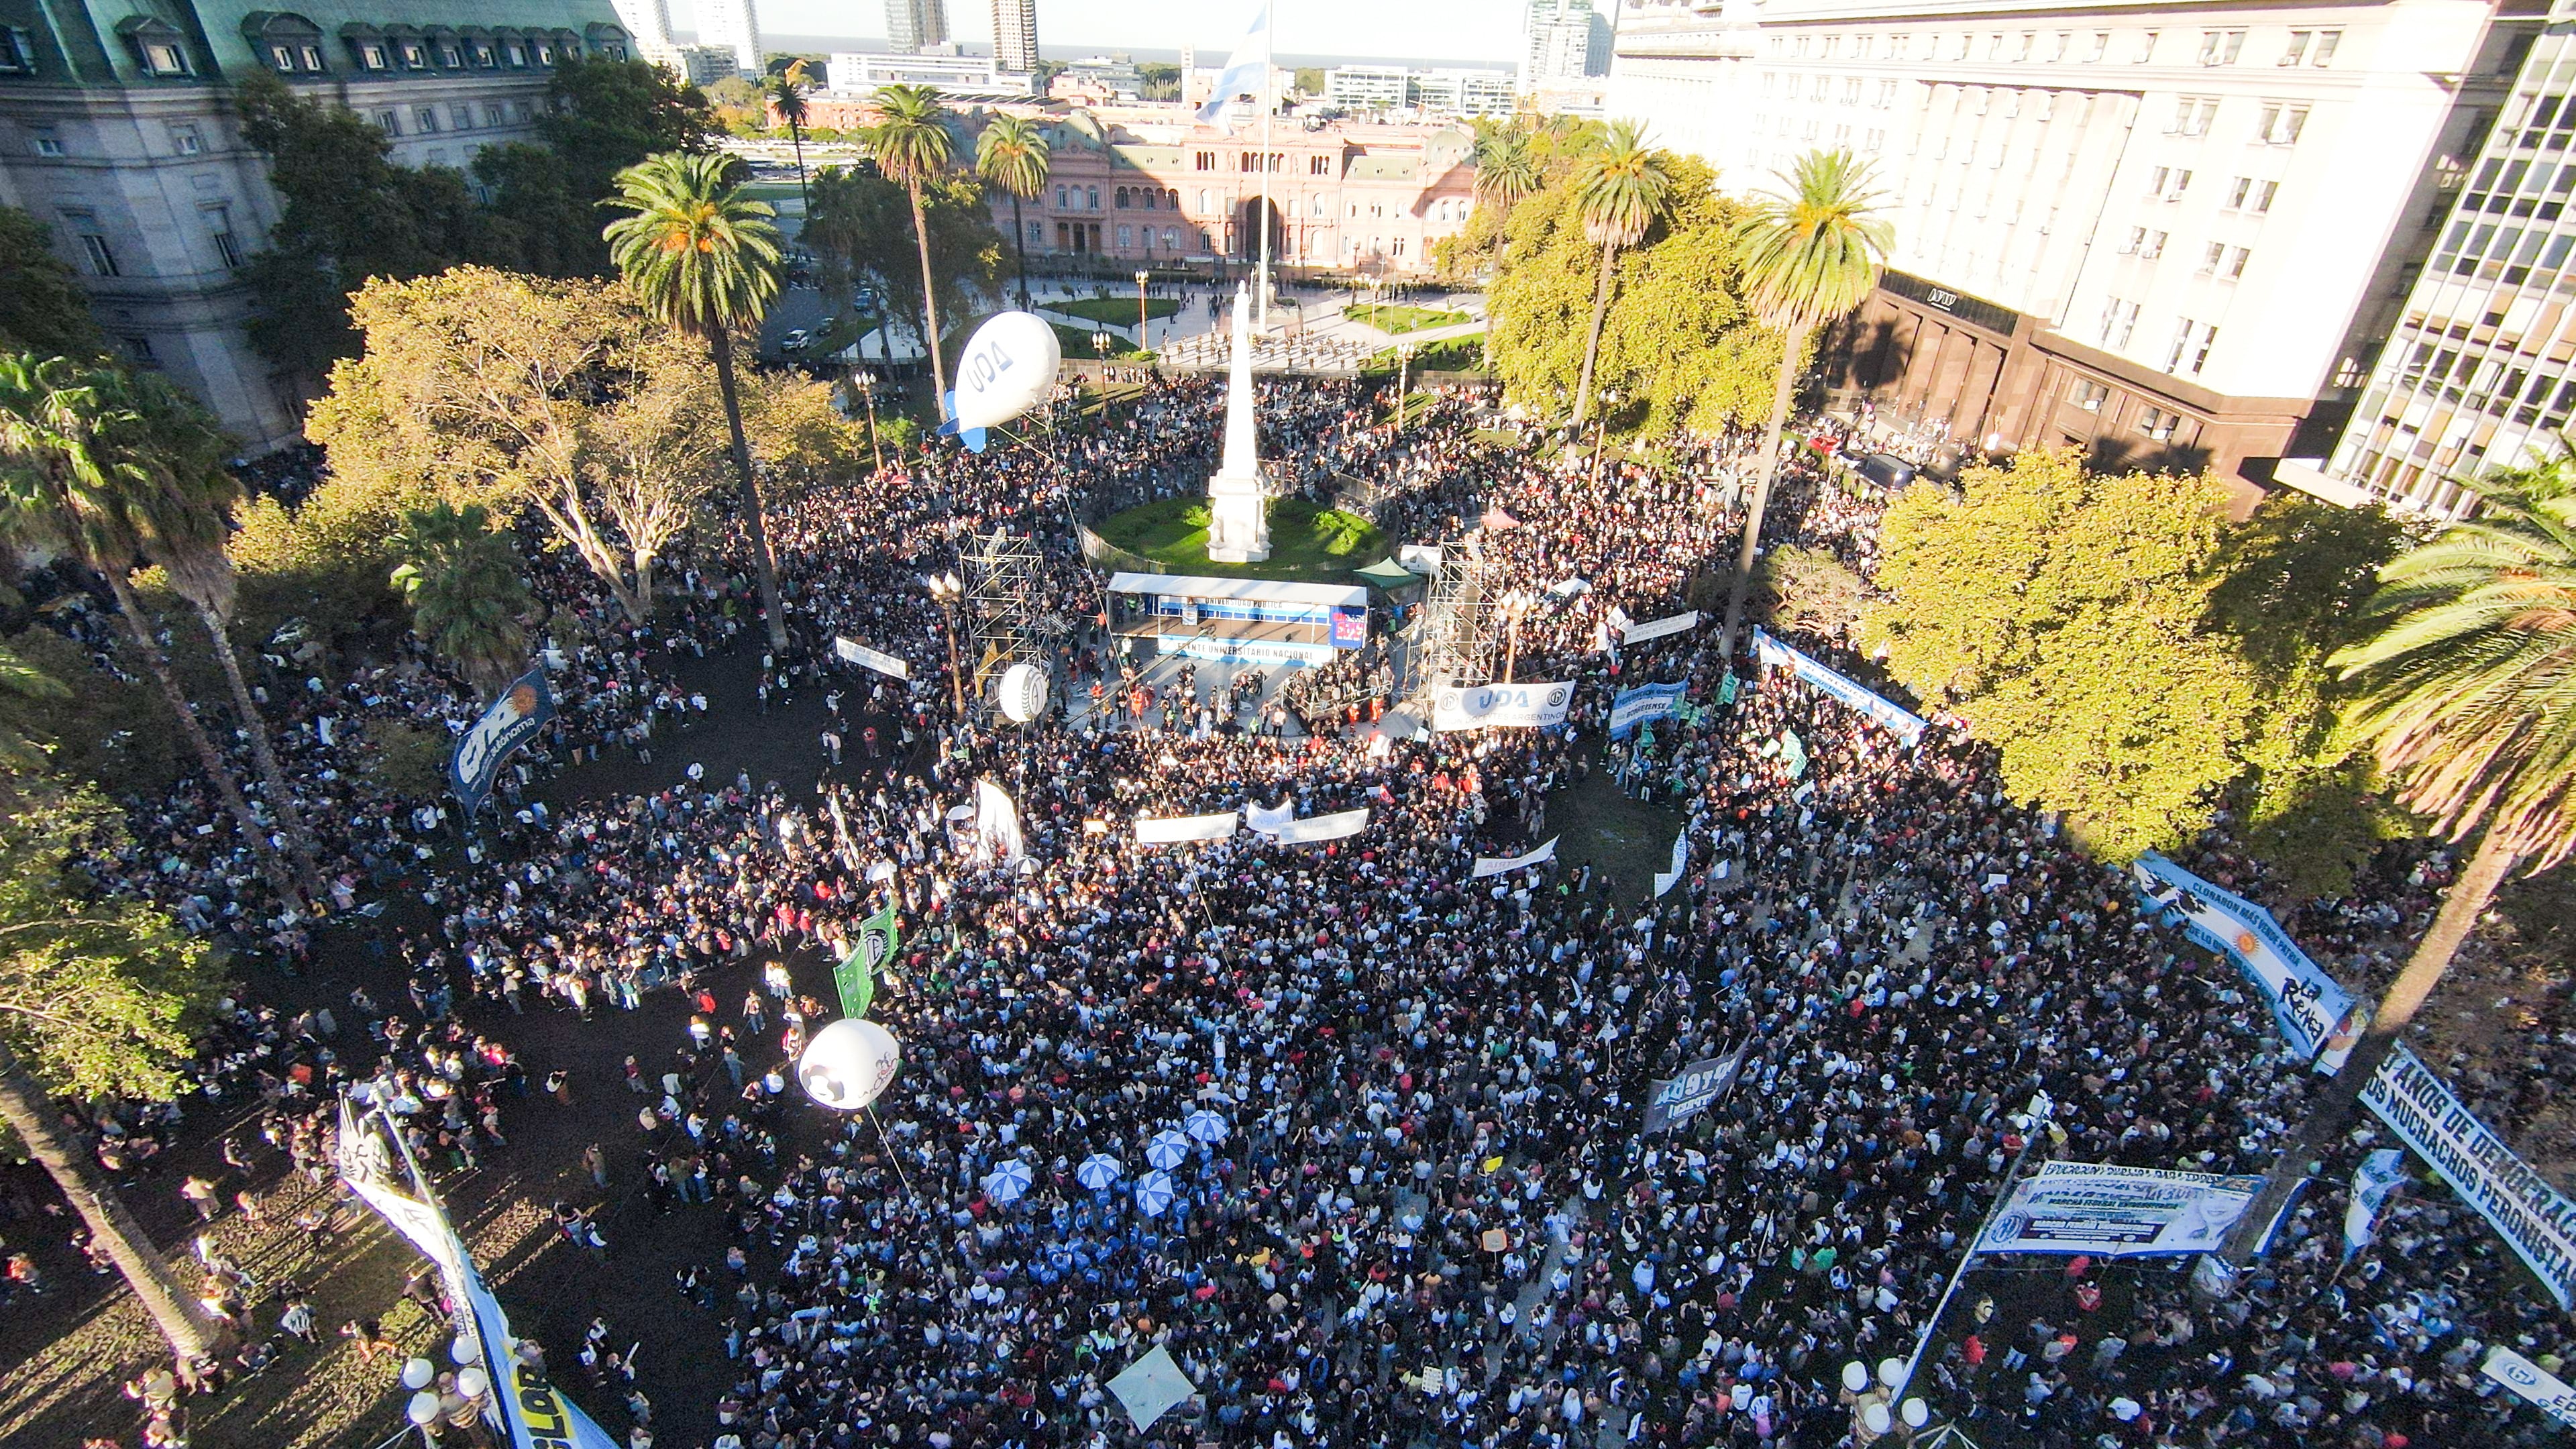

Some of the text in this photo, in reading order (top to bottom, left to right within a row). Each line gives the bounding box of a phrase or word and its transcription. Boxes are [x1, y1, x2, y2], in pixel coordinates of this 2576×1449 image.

[966, 341, 1014, 393] UDA
[1208, 644, 1270, 657] UNIVERSITARIO
[1273, 649, 1313, 660] NACIONAL
[1479, 690, 1529, 708] UDA
[1813, 678, 1847, 699] JUSTICIA
[1511, 710, 1566, 720] ARGENTINOS
[490, 716, 535, 757] autónoma
[2193, 882, 2241, 913] CLONARON
[2188, 925, 2200, 937] DE
[2442, 1107, 2475, 1145] DE
[2385, 1089, 2479, 1193] MUCHACHOS
